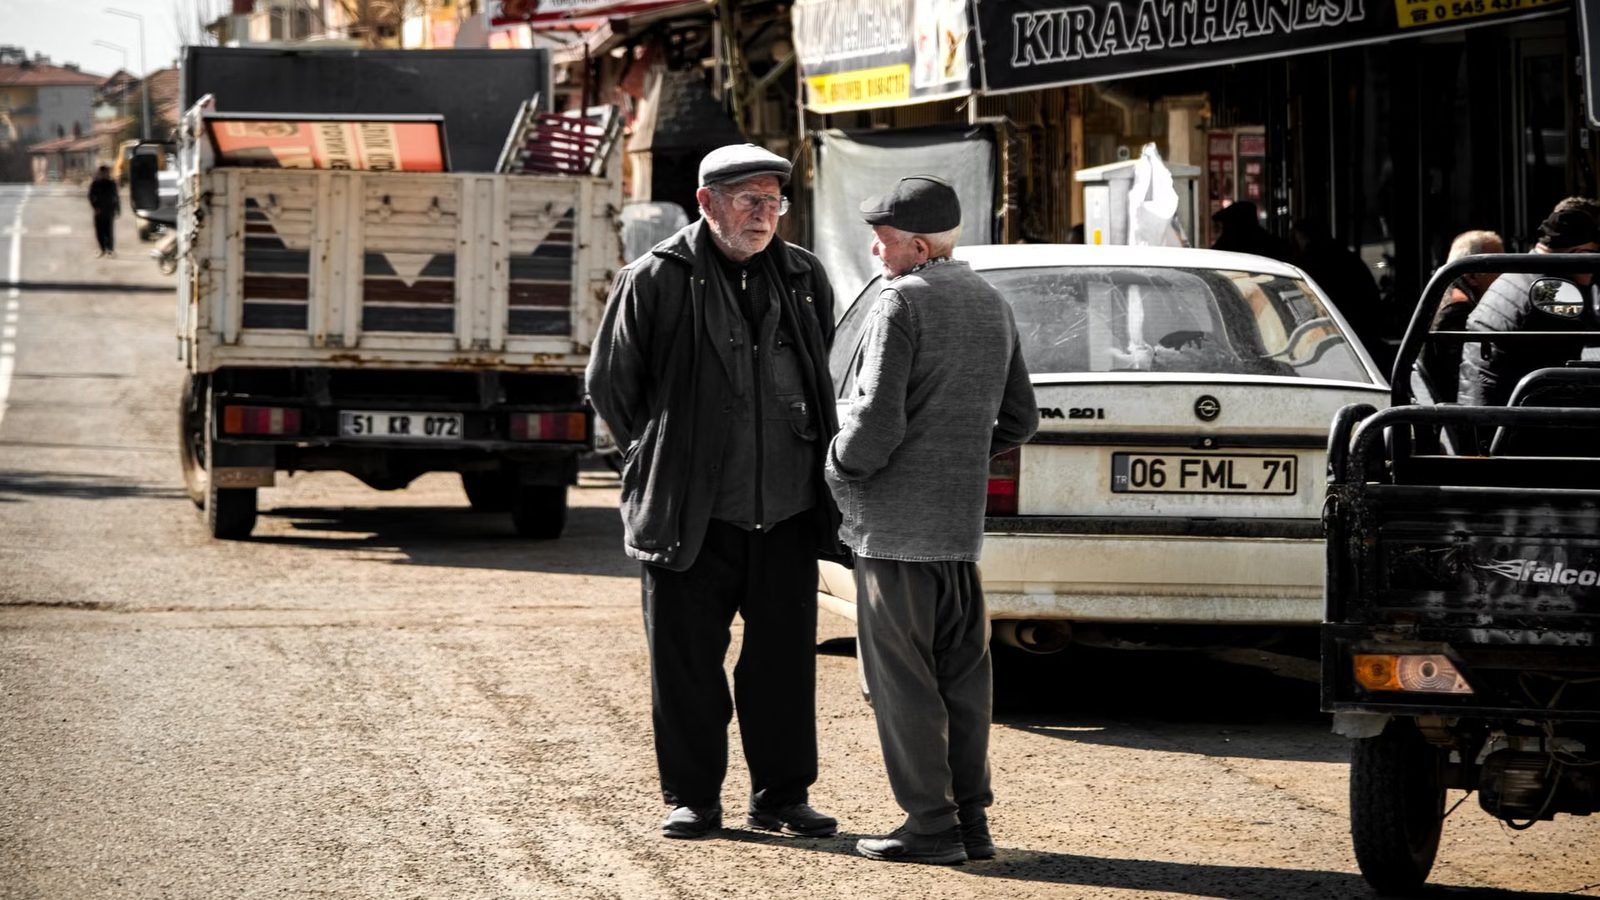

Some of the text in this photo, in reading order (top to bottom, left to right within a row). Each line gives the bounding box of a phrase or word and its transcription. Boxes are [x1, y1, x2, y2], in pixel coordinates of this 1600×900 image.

[353, 415, 459, 436] 51 KR 072
[1115, 475, 1128, 484] TR
[1131, 458, 1292, 490] 06 FML 71
